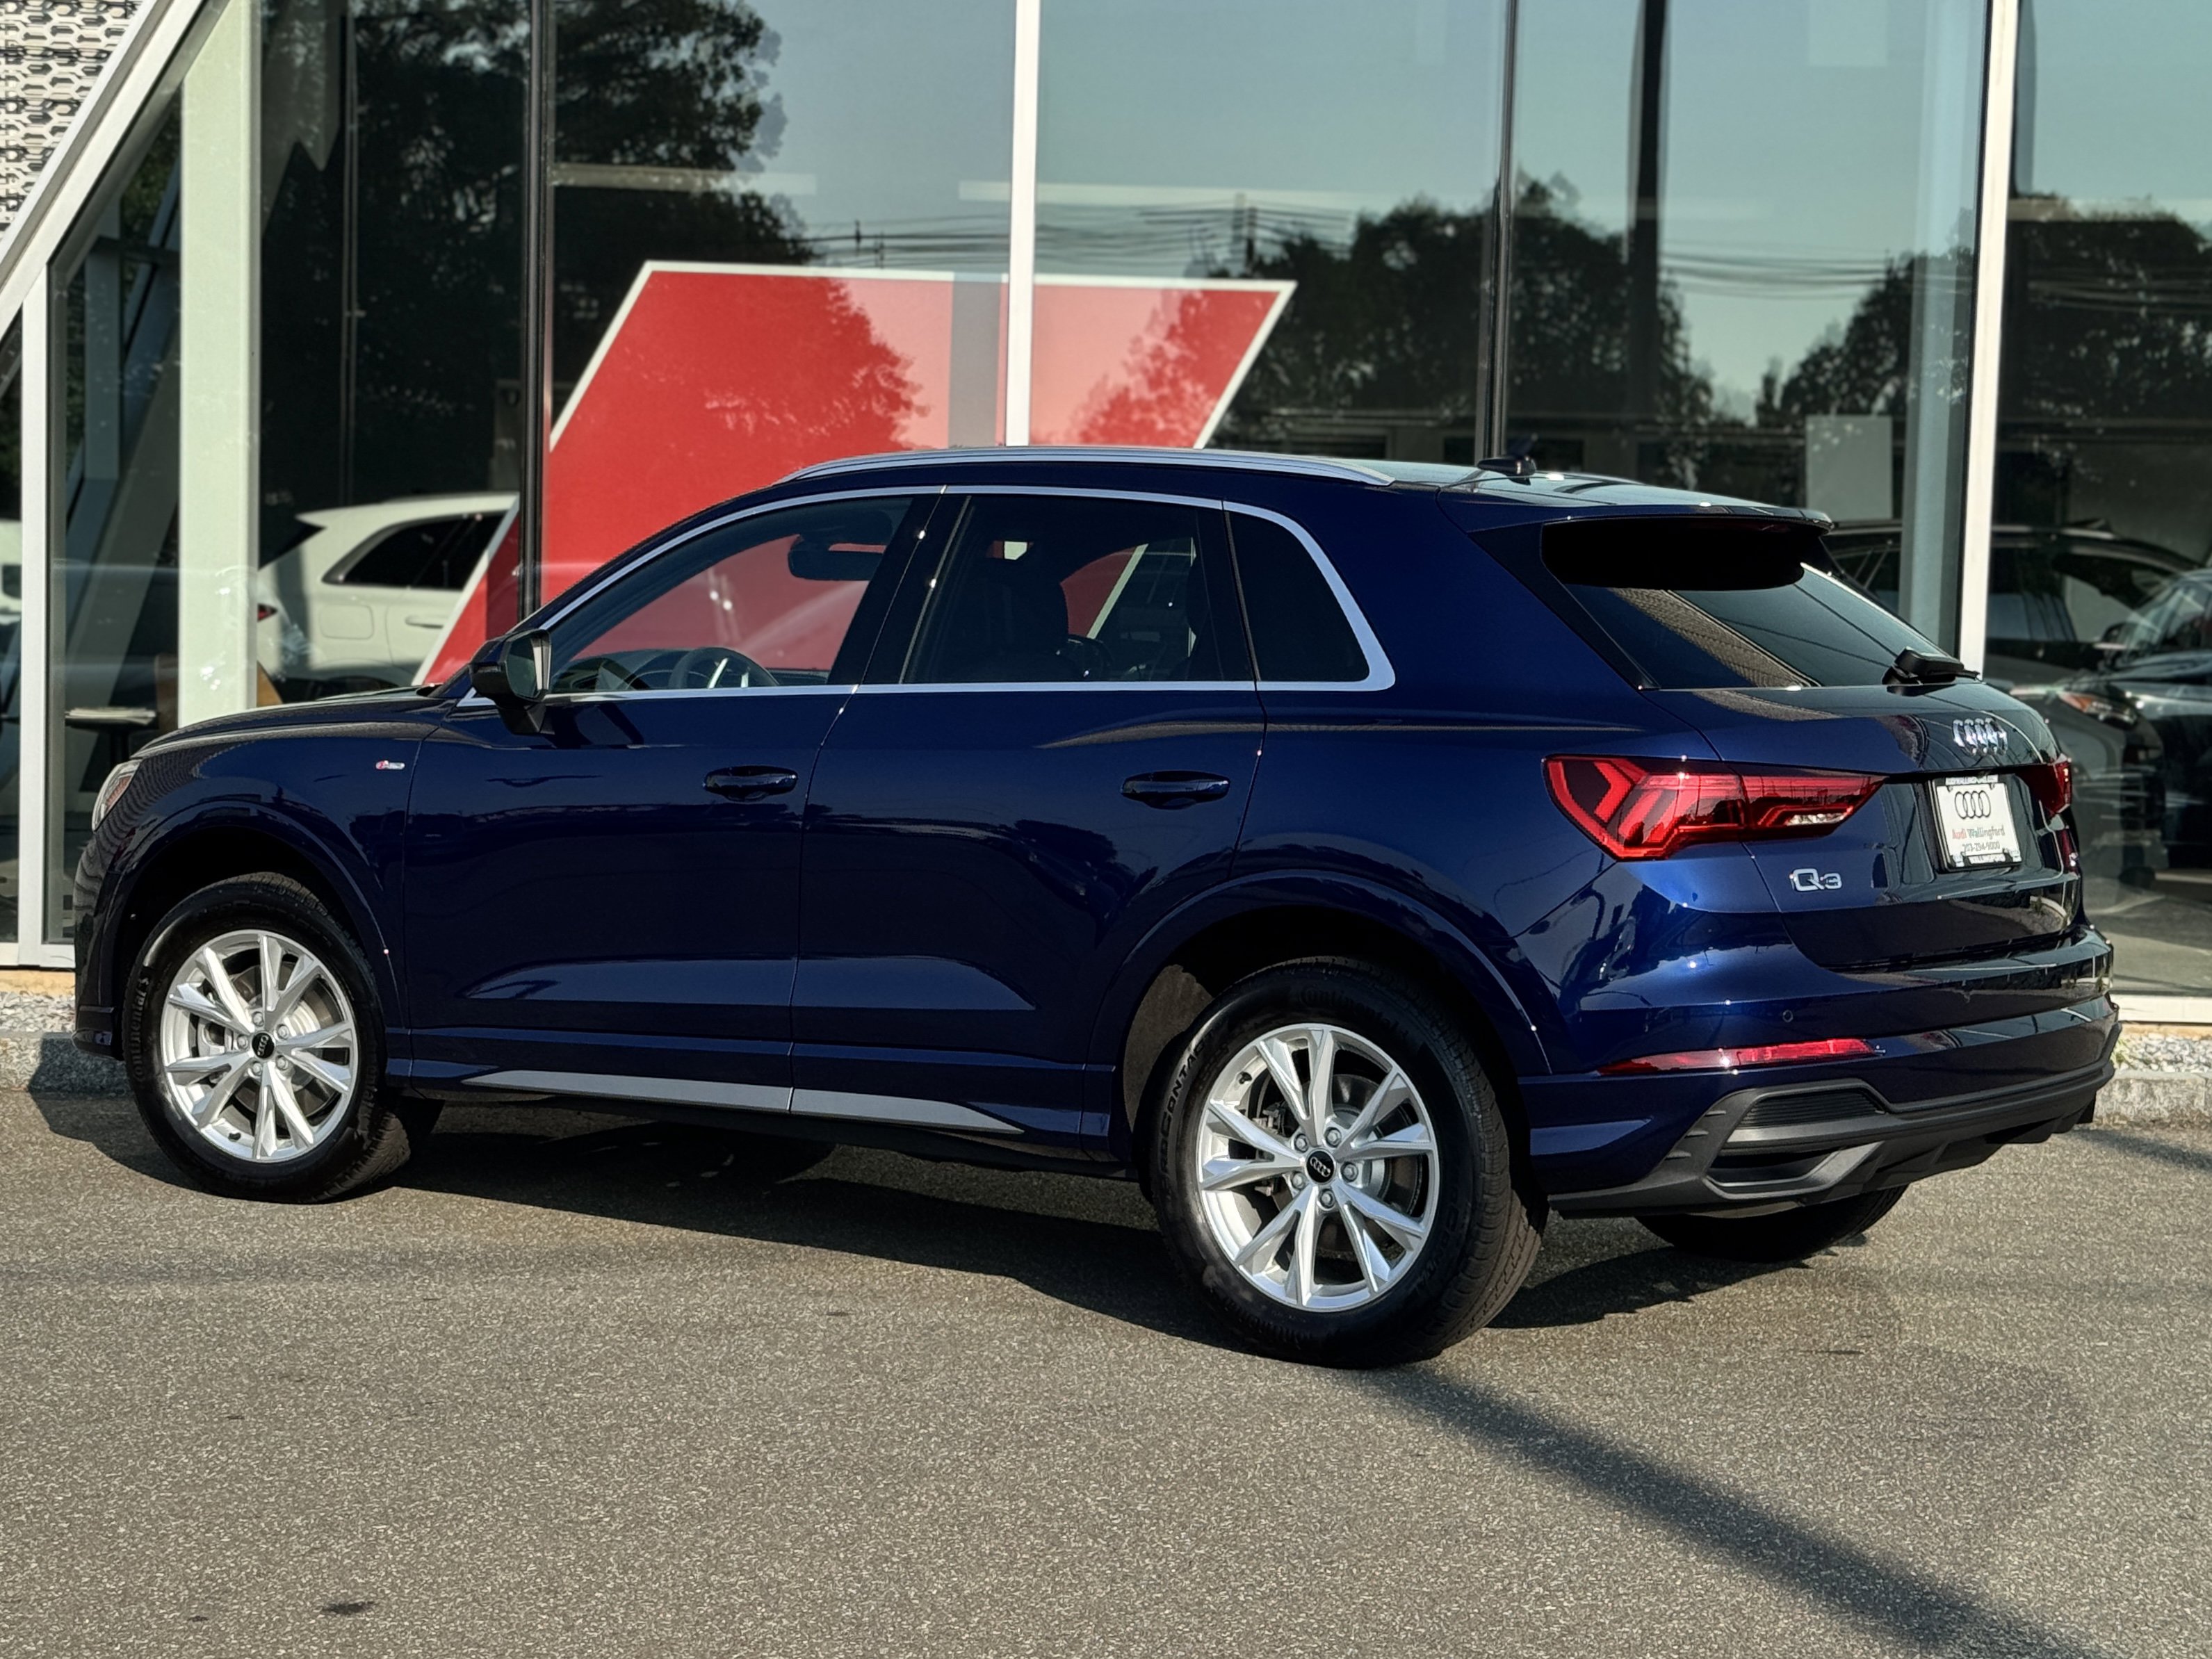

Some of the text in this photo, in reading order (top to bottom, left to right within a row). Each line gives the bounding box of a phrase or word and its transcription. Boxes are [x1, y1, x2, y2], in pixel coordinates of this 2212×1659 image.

[1951, 824, 2006, 840] Audi Wallingford
[1789, 868, 1842, 891] Q3
